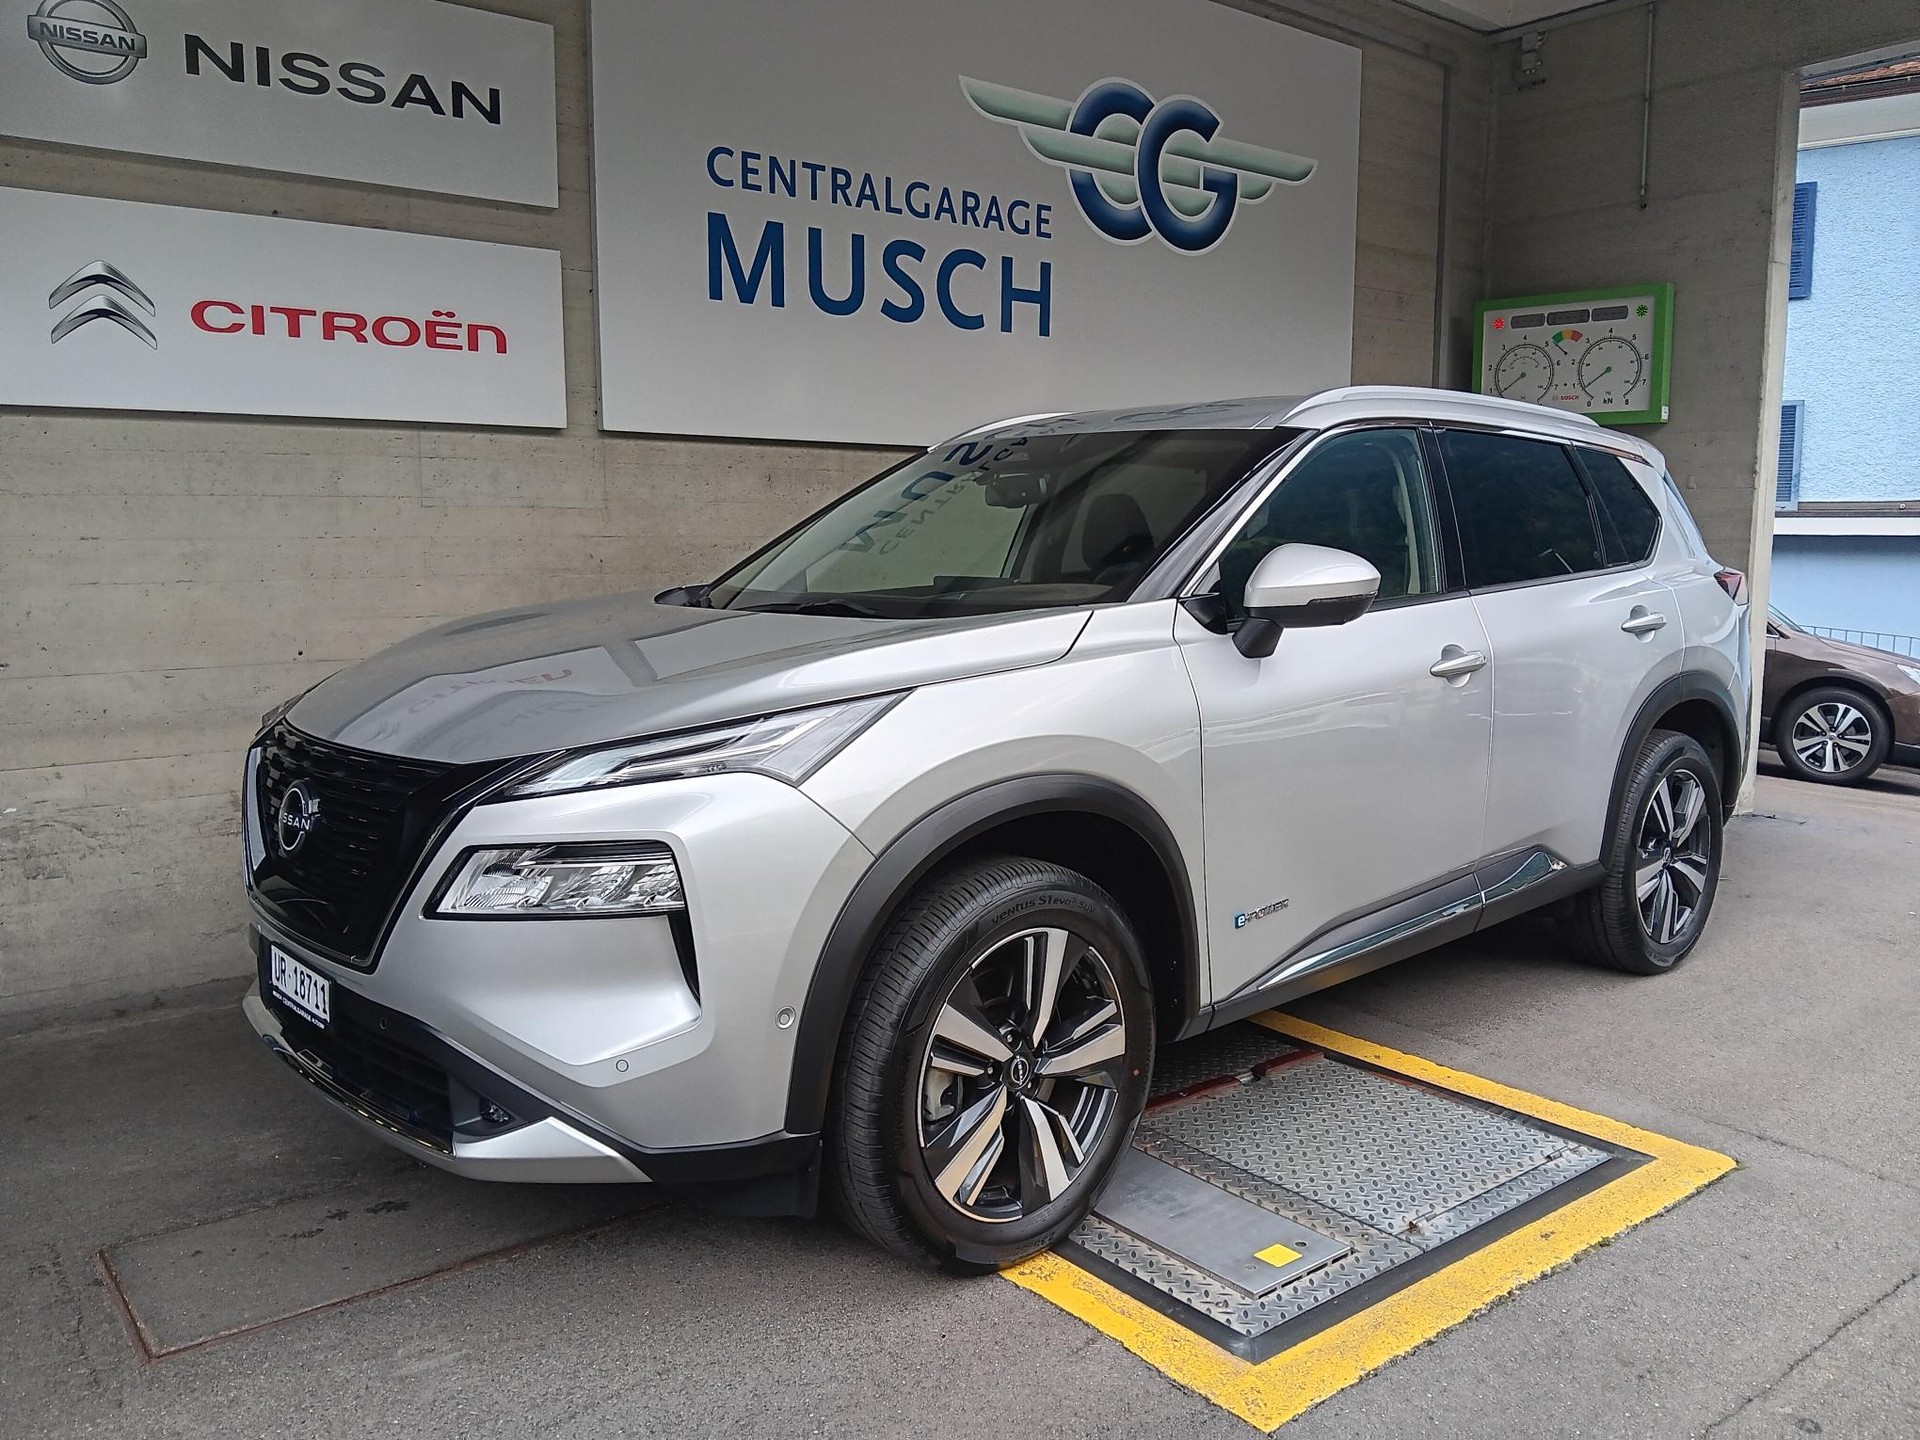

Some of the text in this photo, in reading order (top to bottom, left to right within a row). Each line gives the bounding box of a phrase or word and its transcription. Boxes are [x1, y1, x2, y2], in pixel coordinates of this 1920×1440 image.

[39, 22, 136, 52] NISSAN
[185, 34, 501, 125] NISSAN
[707, 147, 1053, 239] CENTRALGARAGE
[1067, 81, 1239, 253] CG
[708, 212, 1052, 337] MUSCH
[191, 300, 508, 354] CITROËN
[282, 812, 310, 831] SSAN
